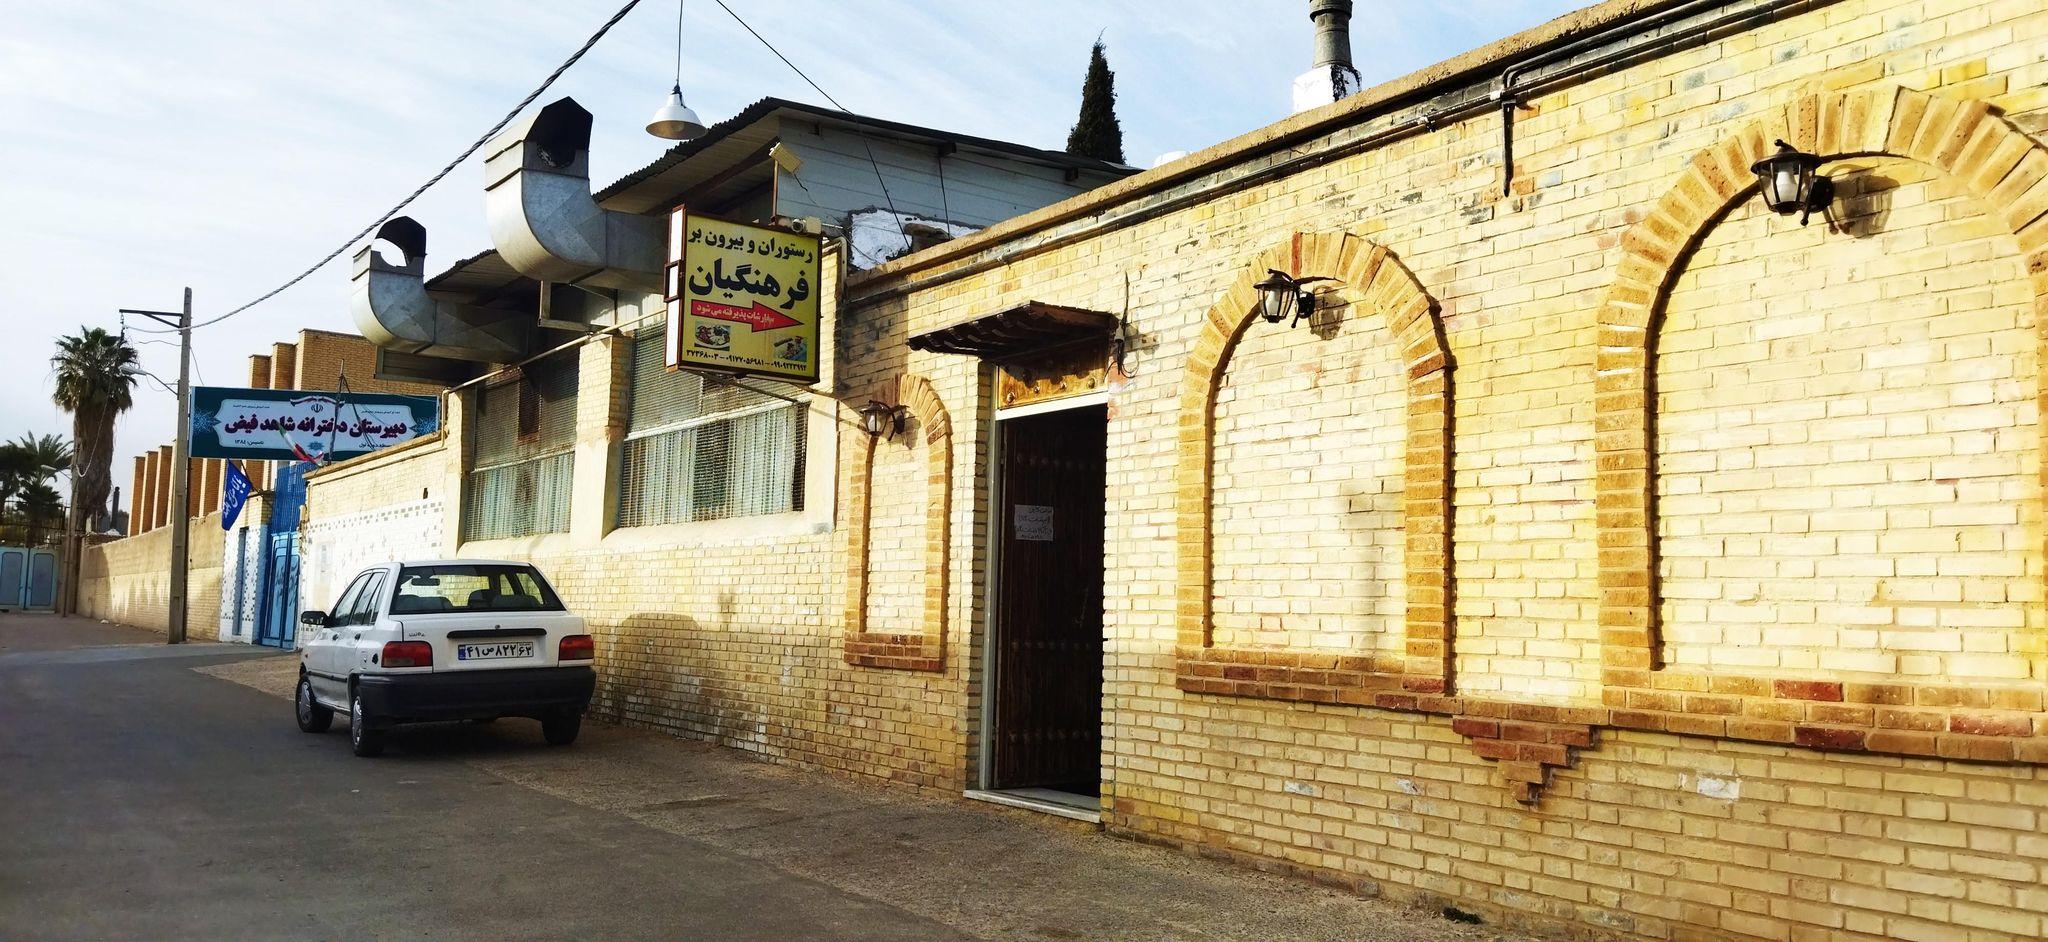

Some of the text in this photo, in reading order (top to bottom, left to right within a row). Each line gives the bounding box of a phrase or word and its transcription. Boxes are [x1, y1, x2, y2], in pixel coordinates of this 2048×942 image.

[688, 227, 813, 264] رستوران و بیرون بر
[688, 257, 809, 310] فرهنگیان
[696, 303, 711, 315] شود
[722, 306, 747, 320] پذیرفته
[224, 413, 408, 439] دبیرستان دخترانه شاهد فیض
